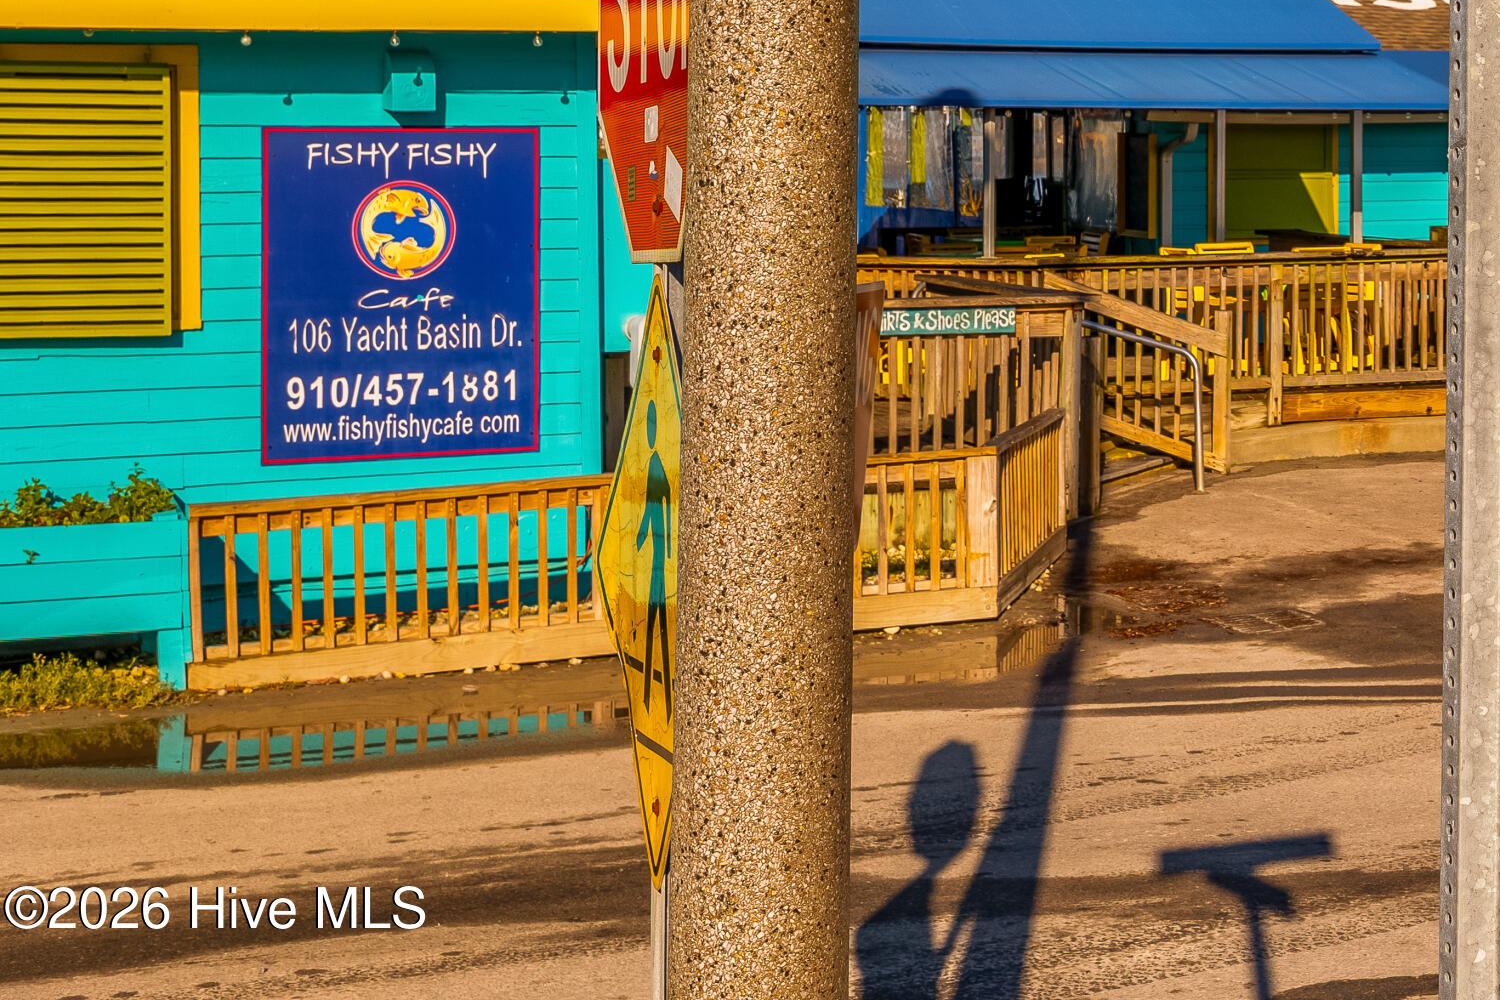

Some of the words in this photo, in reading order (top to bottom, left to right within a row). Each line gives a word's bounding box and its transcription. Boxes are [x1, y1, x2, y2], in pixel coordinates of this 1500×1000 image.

[306, 142, 399, 179] FISHY
[407, 142, 497, 179] FISHY
[358, 287, 455, 311] Cafe
[288, 318, 332, 354] 106
[342, 315, 408, 353] Yacht
[417, 313, 482, 350] Basin
[491, 313, 523, 348] Dr.
[913, 312, 925, 330] &
[925, 310, 971, 331] Shoes
[973, 308, 1016, 330] Please
[286, 369, 517, 411] 910/457-1881
